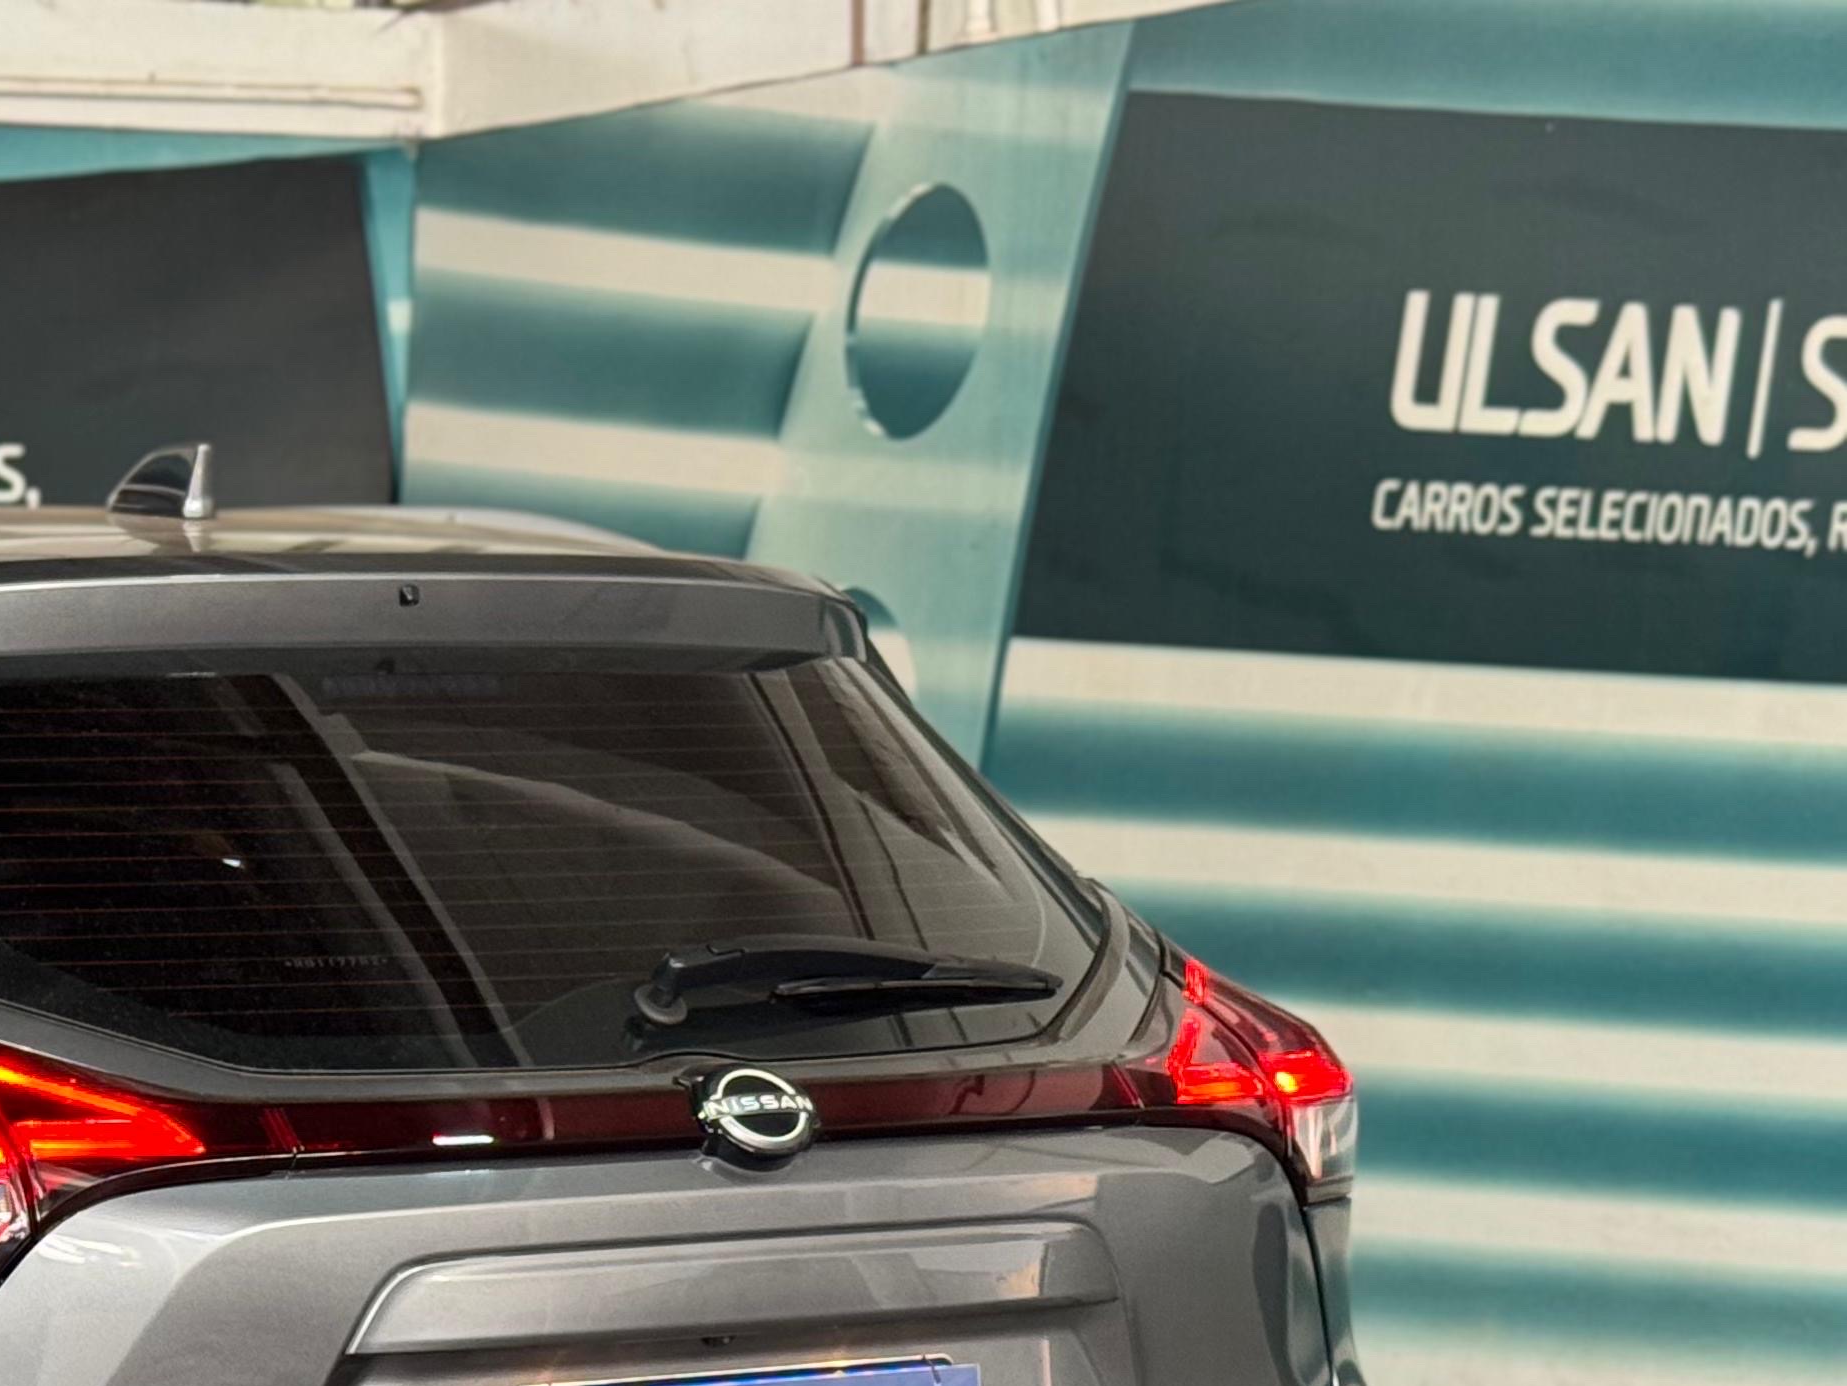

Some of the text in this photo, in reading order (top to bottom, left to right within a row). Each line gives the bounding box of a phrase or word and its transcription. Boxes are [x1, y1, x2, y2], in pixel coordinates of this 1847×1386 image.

[1390, 289, 1743, 447] ULSAN
[1371, 478, 1526, 536] CARROS
[1530, 486, 1819, 557] SELECIONADOS,
[706, 1093, 814, 1116] NISSAN
